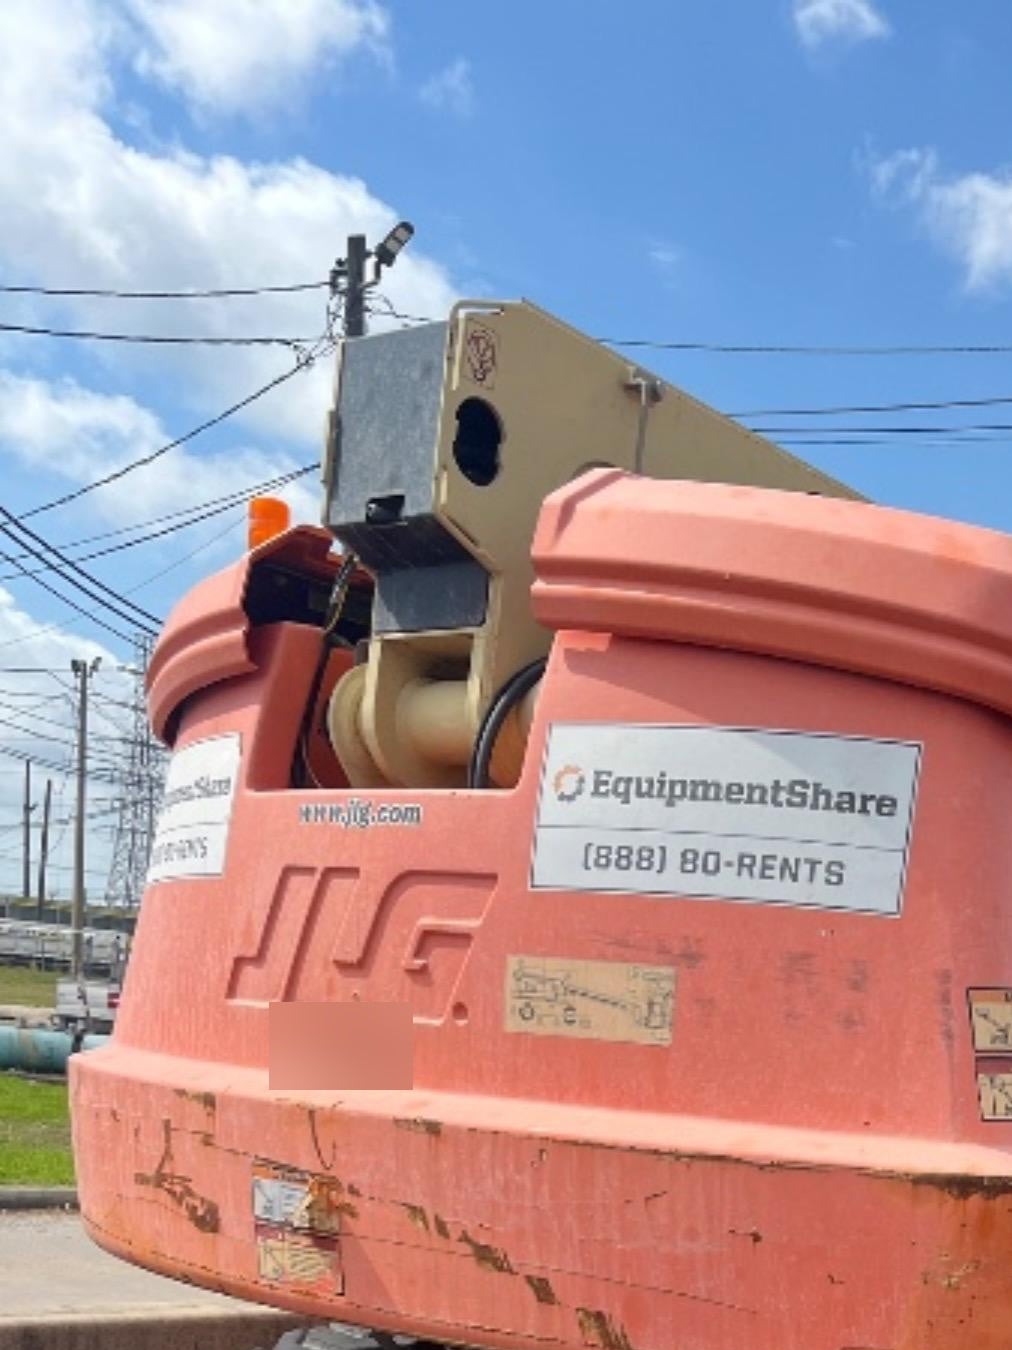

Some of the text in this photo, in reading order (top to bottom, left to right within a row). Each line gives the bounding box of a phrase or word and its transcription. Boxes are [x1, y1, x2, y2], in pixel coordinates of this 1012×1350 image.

[299, 799, 421, 829] www.jlg.com
[590, 769, 898, 818] EquipmentShare
[582, 842, 846, 887] (888) 80-RENTS
